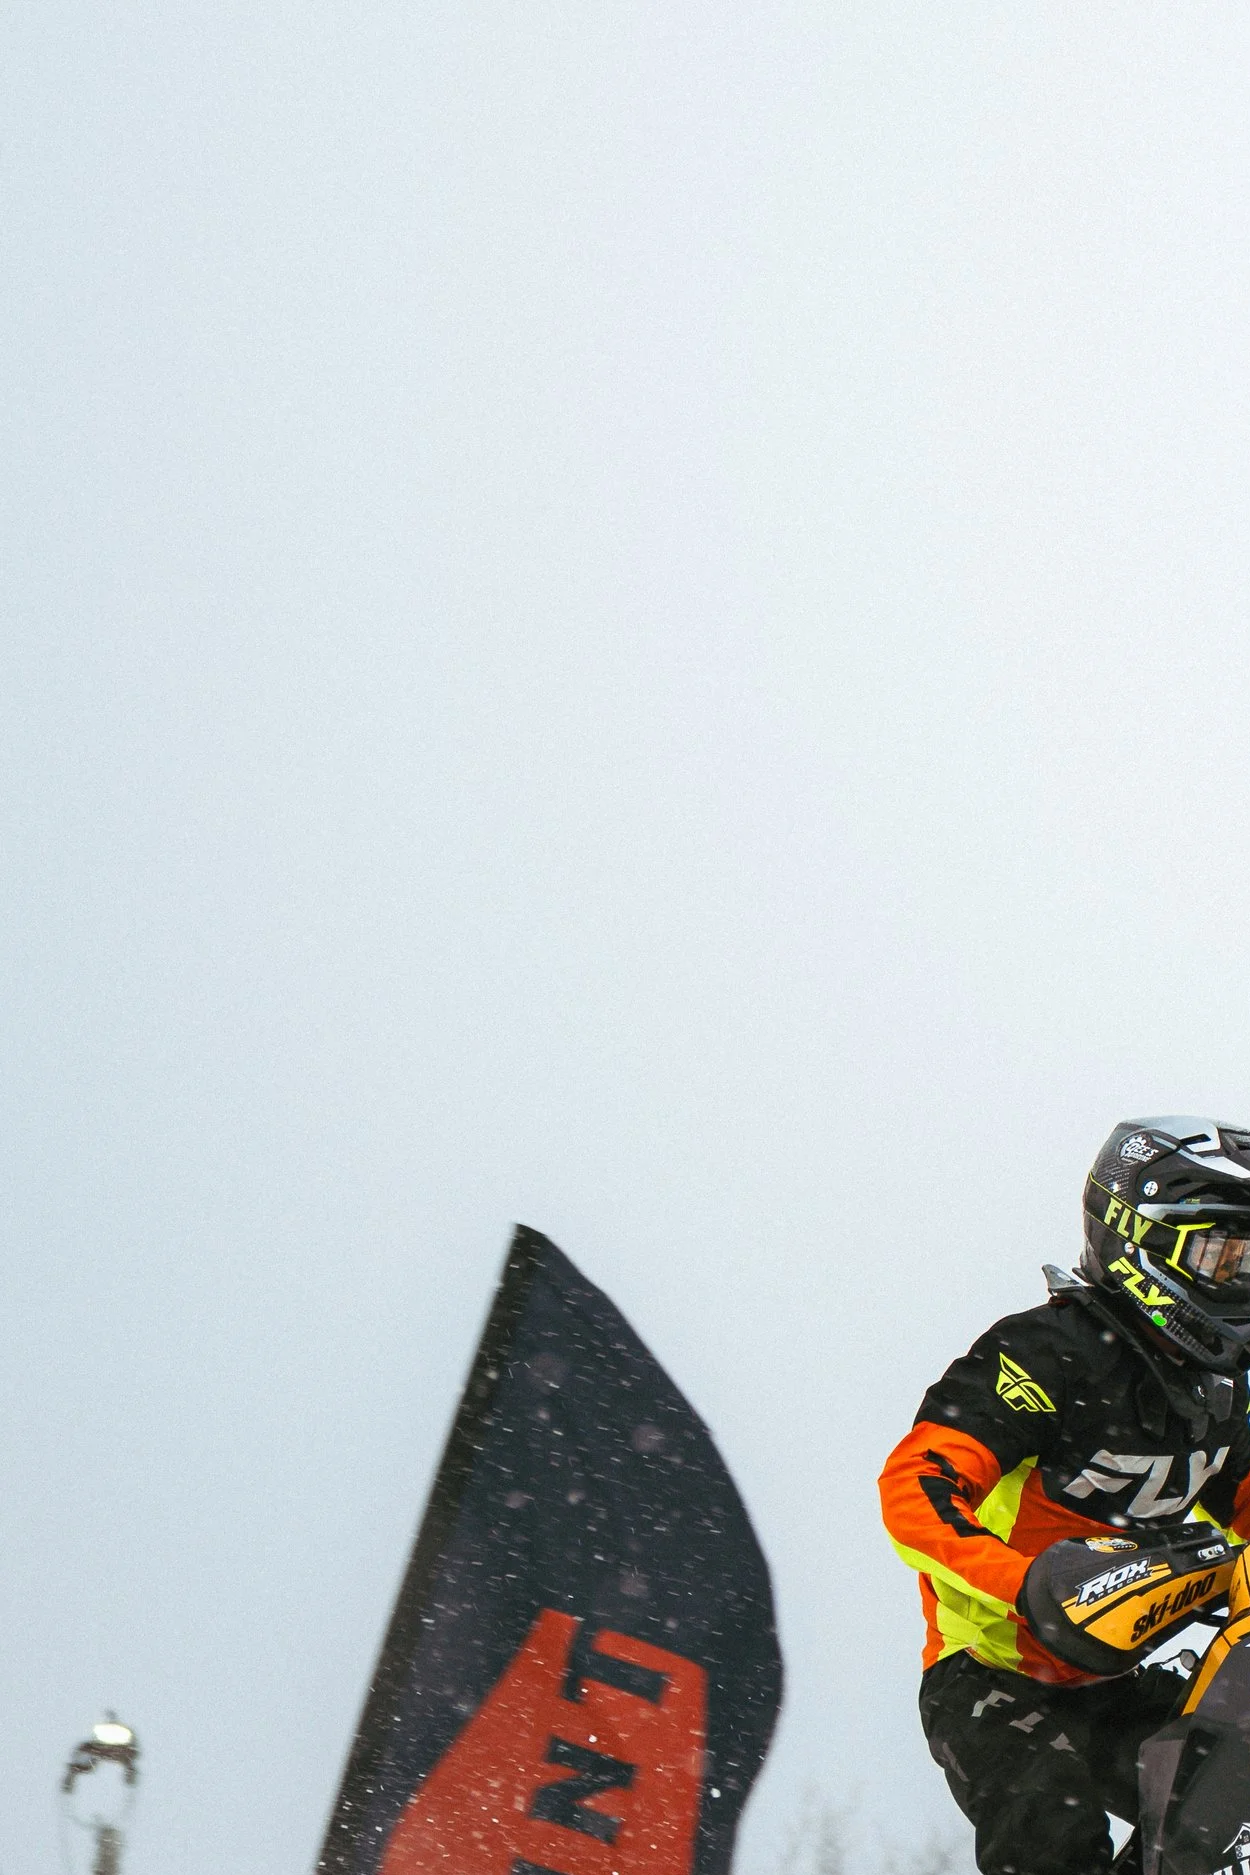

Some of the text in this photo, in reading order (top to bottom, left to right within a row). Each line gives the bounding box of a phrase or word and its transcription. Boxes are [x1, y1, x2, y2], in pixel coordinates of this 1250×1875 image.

[1103, 1196, 1153, 1244] FLY
[1107, 1256, 1175, 1306] FLY
[1063, 1446, 1230, 1519] FLY
[1079, 1558, 1149, 1606] ROX
